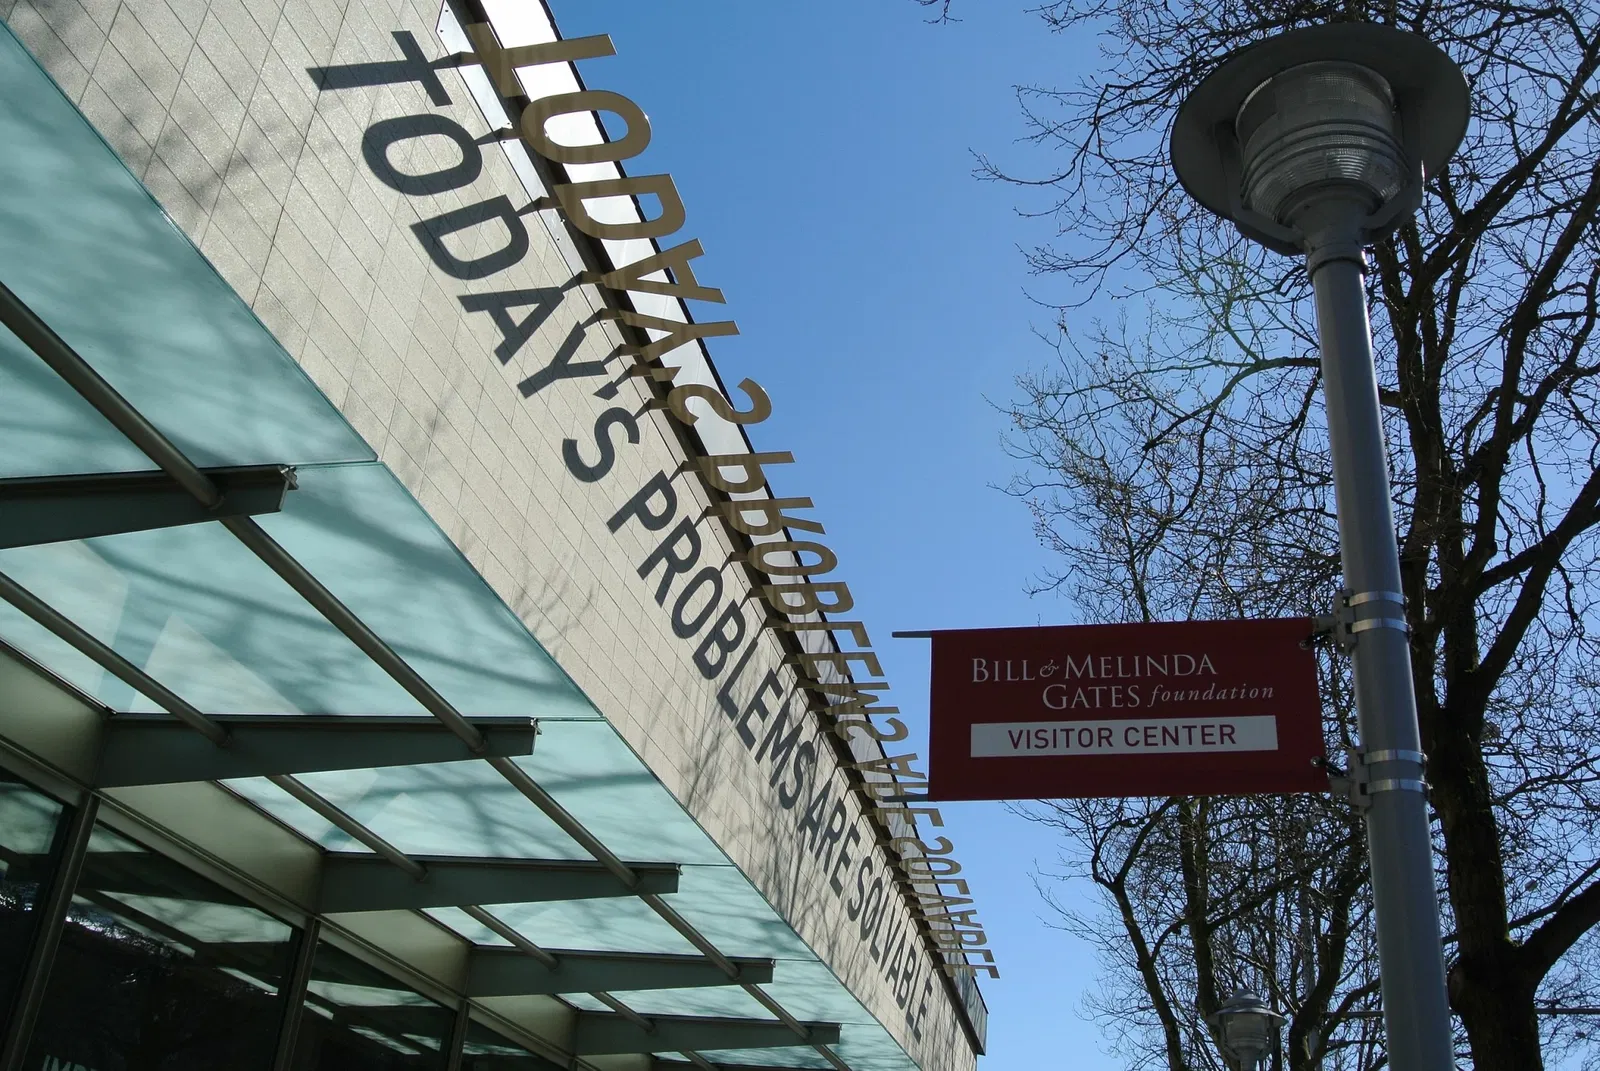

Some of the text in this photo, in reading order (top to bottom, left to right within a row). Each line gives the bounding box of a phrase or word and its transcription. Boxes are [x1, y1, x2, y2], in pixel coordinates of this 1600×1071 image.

[305, 30, 933, 1045] TODAY'S PROBLEMS ARE SOLVABLE
[972, 653, 1218, 682] BILL & MELINDA
[1043, 684, 1274, 710] GATES foundation
[1008, 724, 1237, 750] VISITOR CENTER
